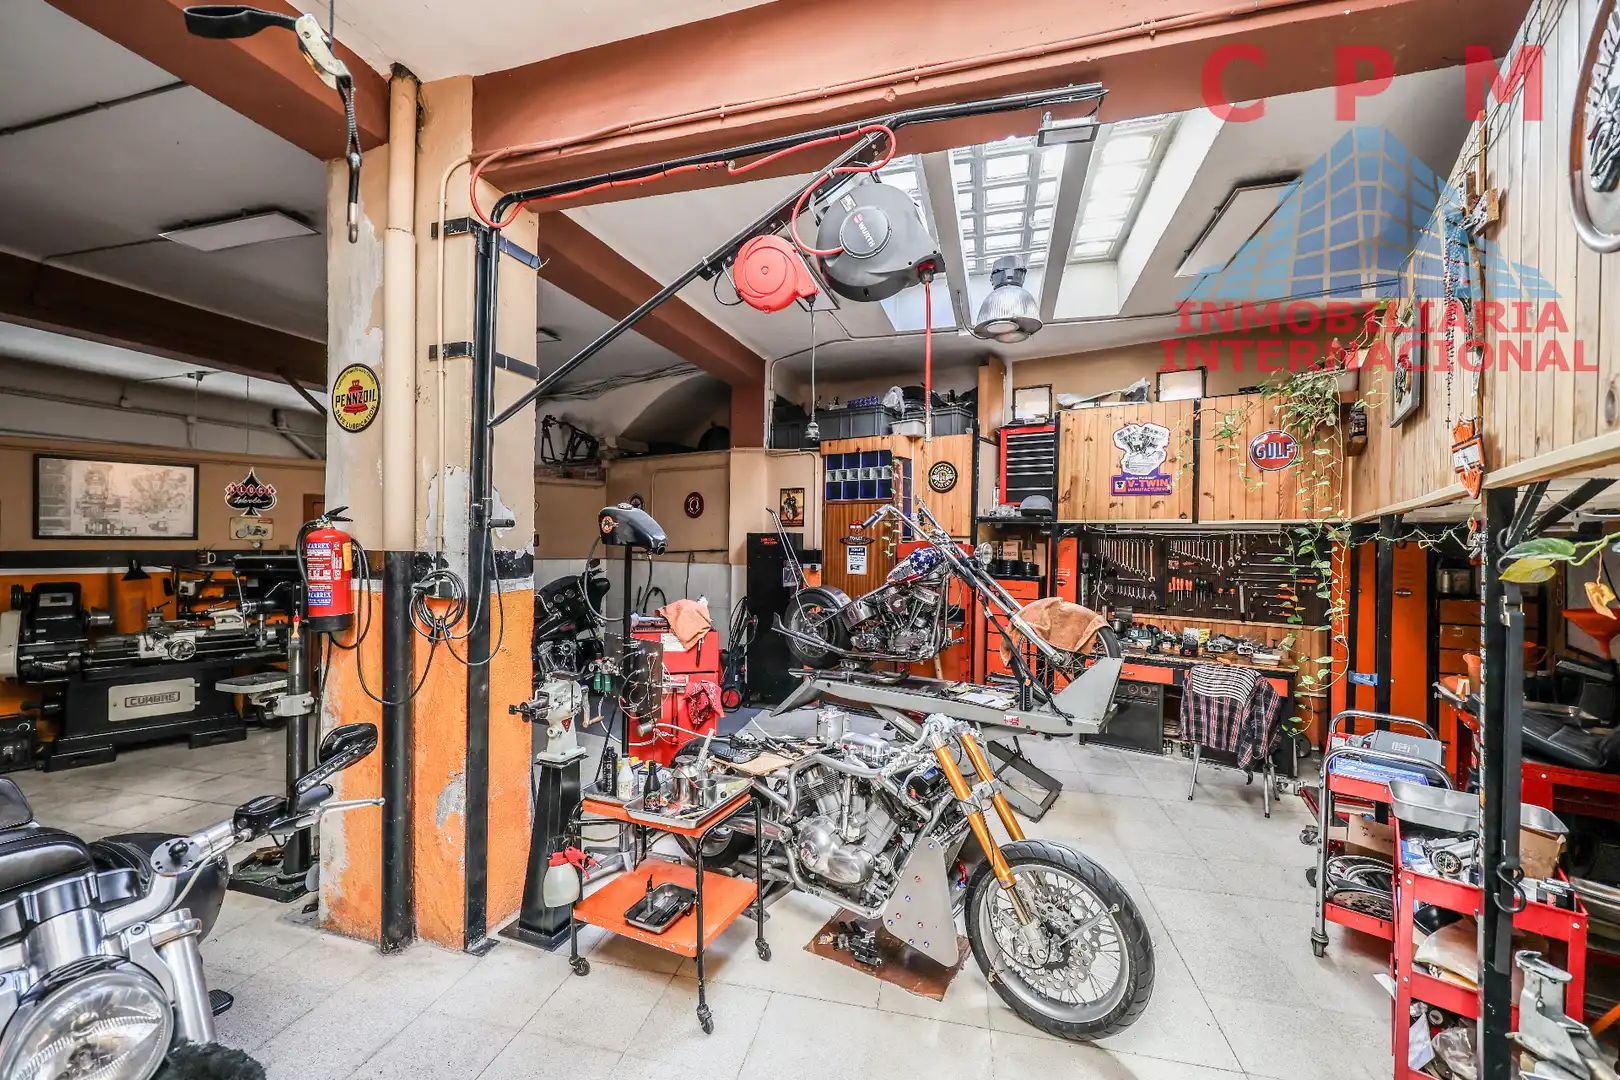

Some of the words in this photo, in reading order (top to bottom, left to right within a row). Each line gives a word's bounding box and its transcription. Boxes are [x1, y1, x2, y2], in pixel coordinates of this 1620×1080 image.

[335, 388, 377, 408] PENNZOIL
[1253, 441, 1294, 460] GULF
[227, 484, 275, 496] KLOCK
[1127, 479, 1168, 488] V-TWIN
[130, 693, 176, 706] CUMBRE
